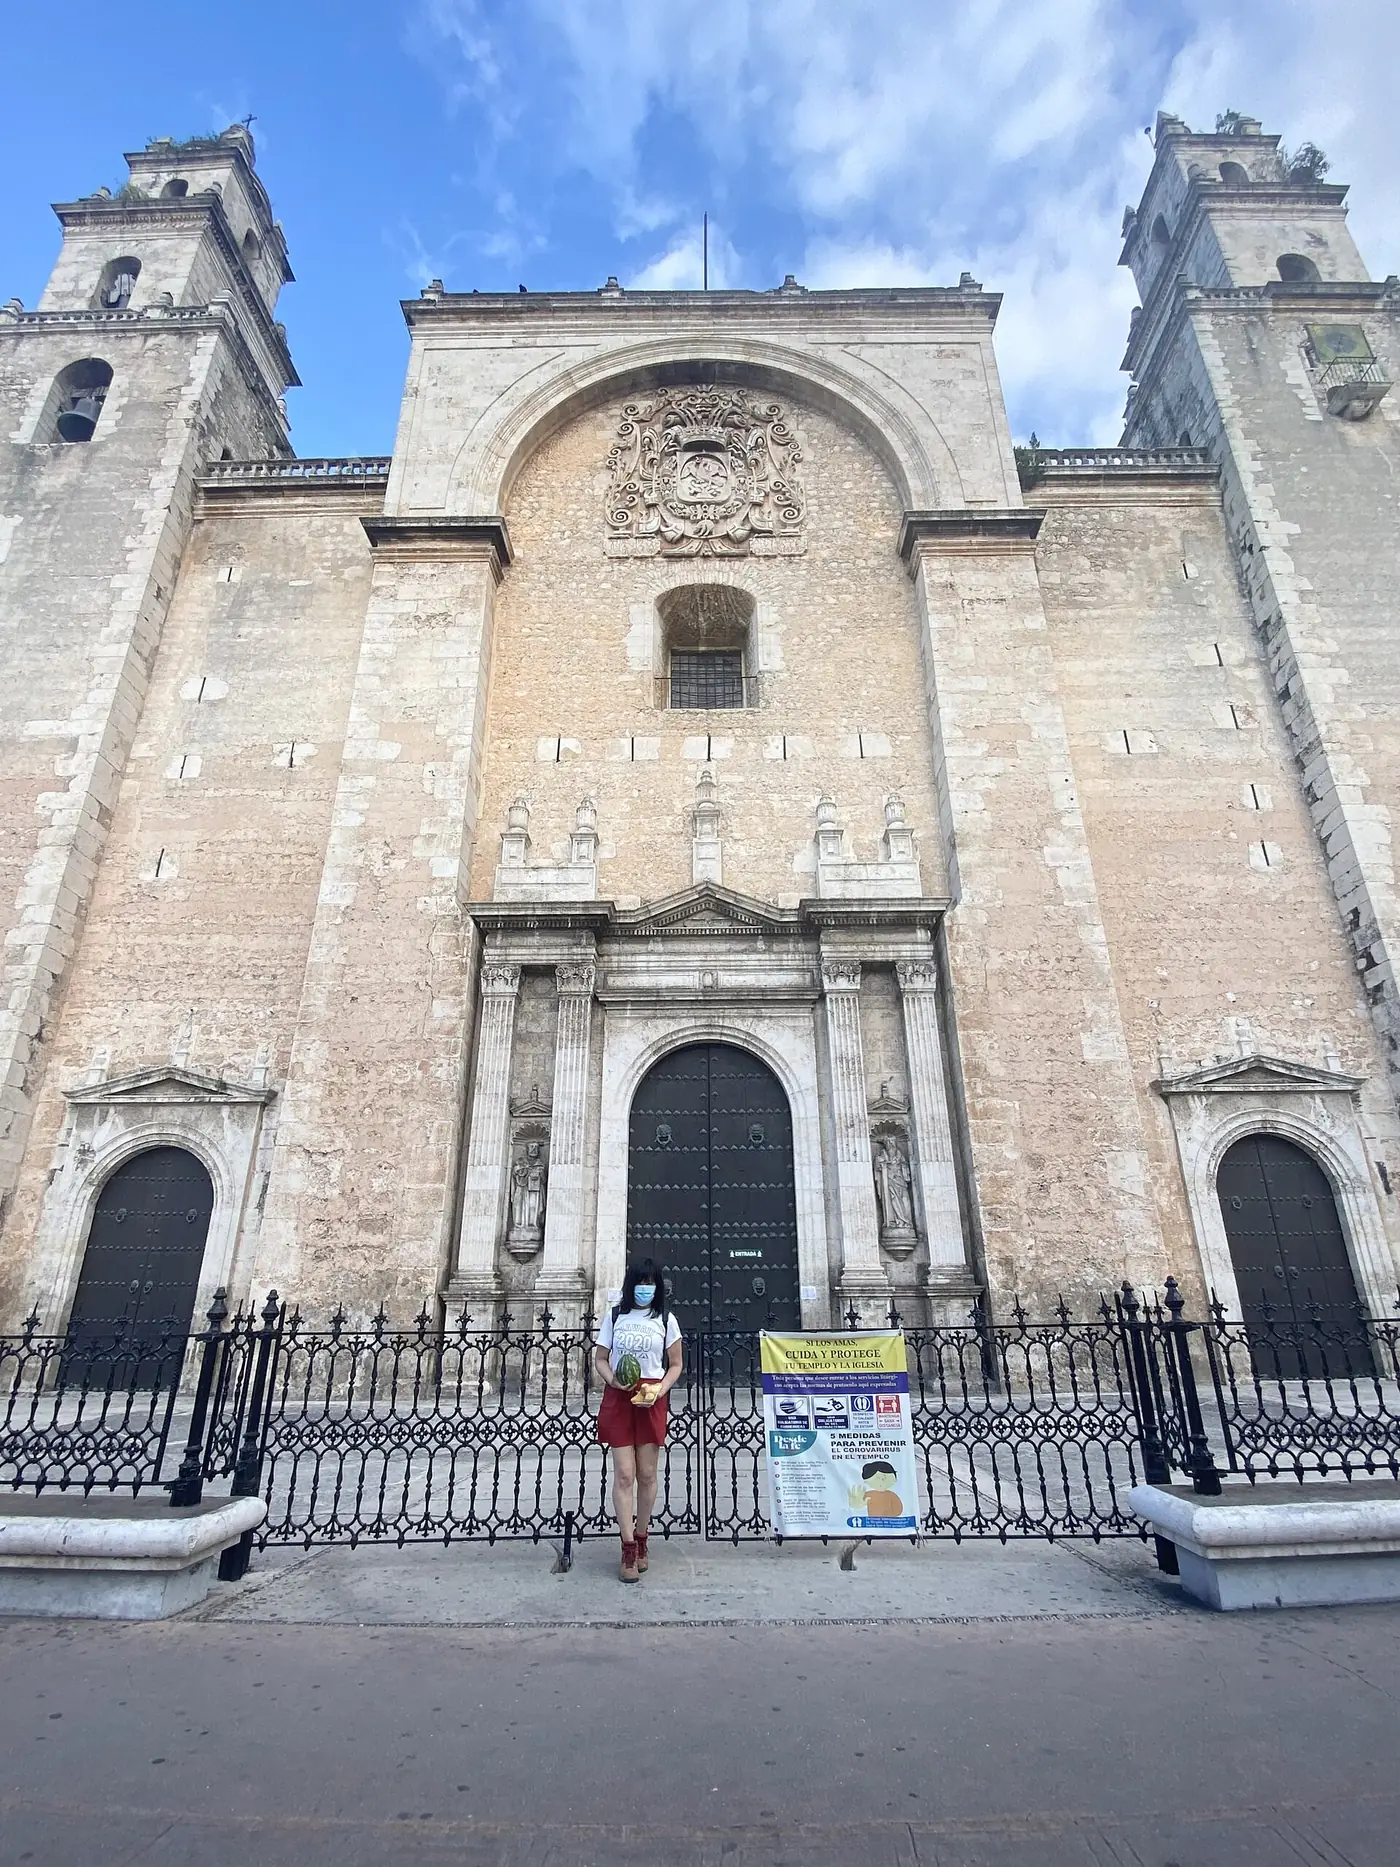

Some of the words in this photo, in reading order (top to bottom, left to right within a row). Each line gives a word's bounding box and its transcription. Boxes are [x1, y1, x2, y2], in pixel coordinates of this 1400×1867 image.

[616, 1332, 652, 1352] 2020
[785, 1350, 818, 1359] CUIDA
[821, 1350, 827, 1358] Y
[831, 1349, 881, 1358] PROTEGE
[774, 1434, 807, 1443] Desde
